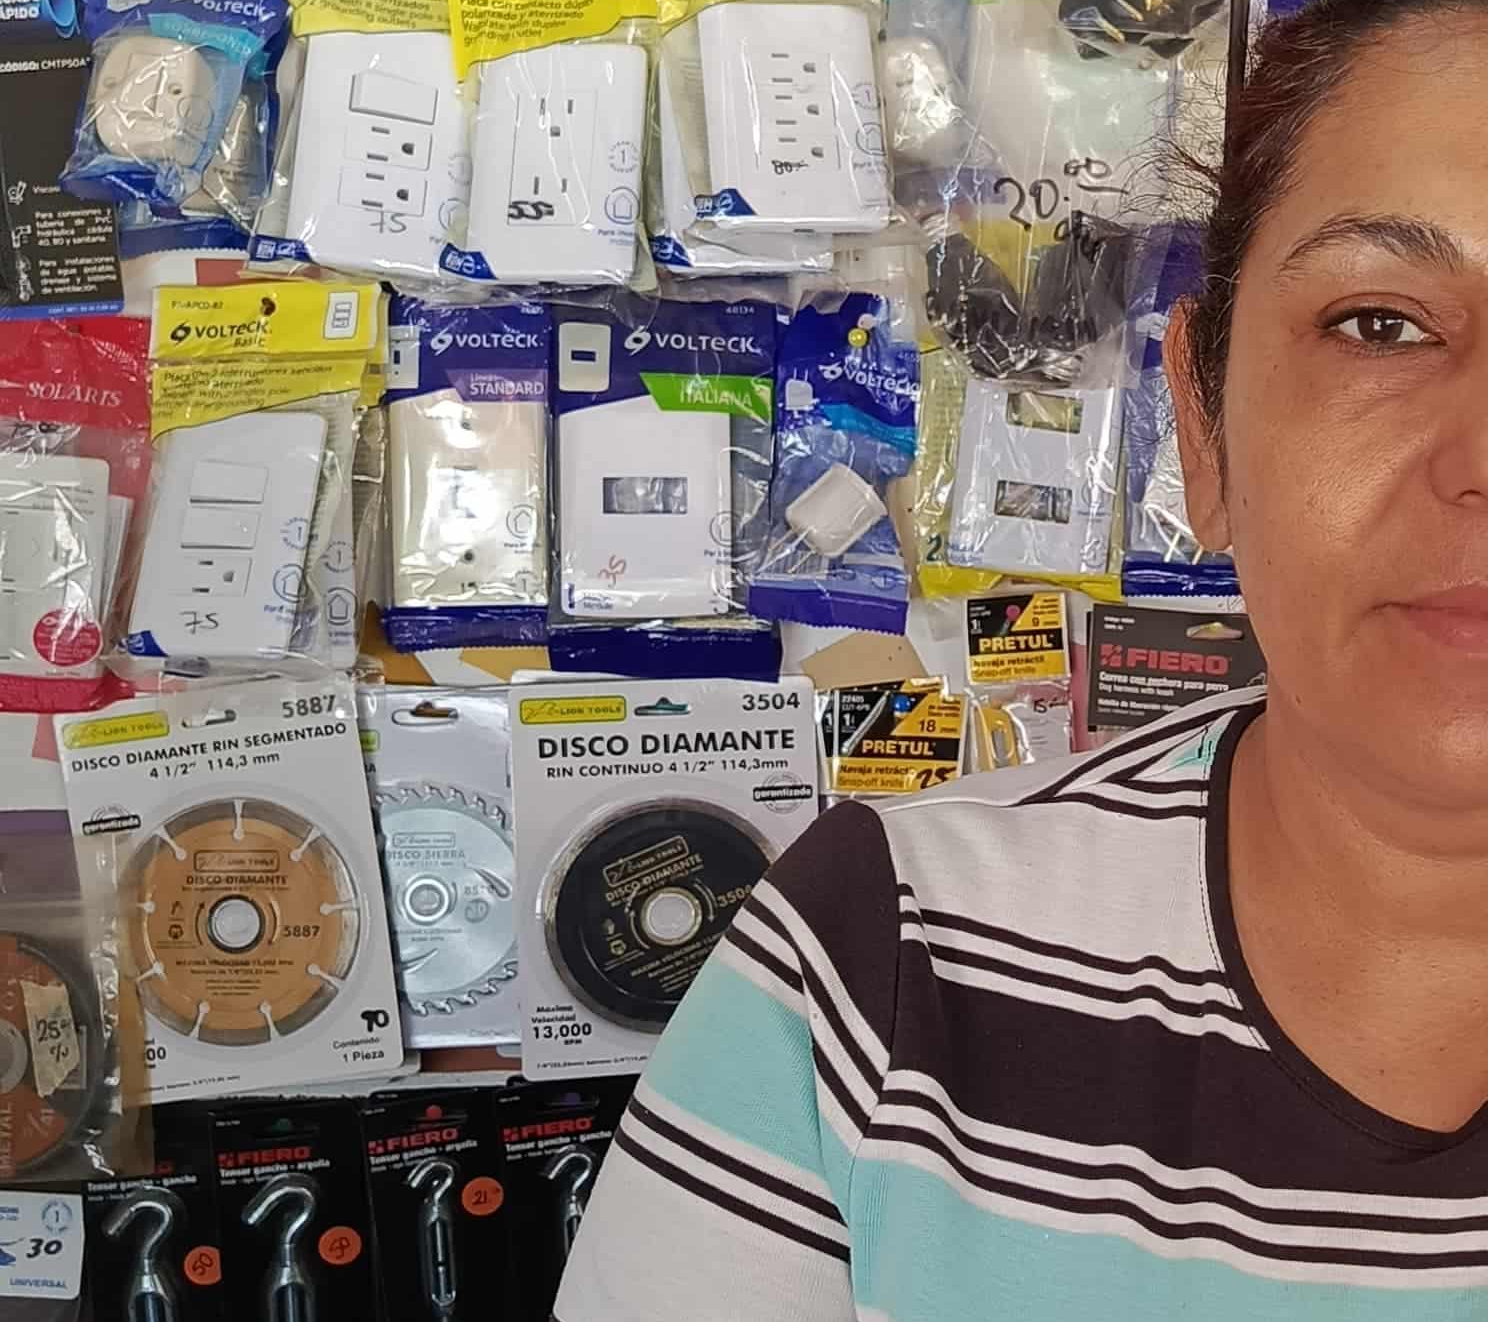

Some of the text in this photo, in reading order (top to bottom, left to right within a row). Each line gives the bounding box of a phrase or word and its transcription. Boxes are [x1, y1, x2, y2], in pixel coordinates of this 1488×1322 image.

[25, 380, 123, 406] SOLARIS
[469, 380, 545, 396] STANDARD
[680, 383, 752, 407] ITALIANA
[184, 611, 219, 631] 75
[978, 635, 1053, 651] PRETUL
[1126, 647, 1229, 675] FIERO
[1099, 672, 1128, 683] Correa
[1205, 683, 1229, 692] perro
[281, 695, 336, 718] 5887
[741, 692, 800, 712] 3504
[918, 719, 936, 733] 18
[71, 723, 348, 772] DISCO DIAMANTE RIN SEGMENTADO
[537, 729, 796, 759] DISCO DIAMANTE
[862, 738, 935, 755] PRETUL
[253, 752, 280, 765] mm
[546, 756, 789, 778] RIN CONTINUO 114,3mm
[839, 764, 871, 776] Navaja
[753, 785, 813, 799] garantizado
[82, 816, 141, 834] garantizado
[186, 875, 287, 885] DISCO DIAMANTE
[282, 925, 320, 938] 5887
[531, 1022, 593, 1040] 13,000
[353, 1049, 385, 1062] Pieza
[386, 1128, 458, 1148] FIERO
[521, 1118, 595, 1139] FIERO
[237, 1146, 312, 1165] FIERO
[26, 1238, 62, 1258] 30
[9, 1278, 67, 1289] UNIVERSAL
